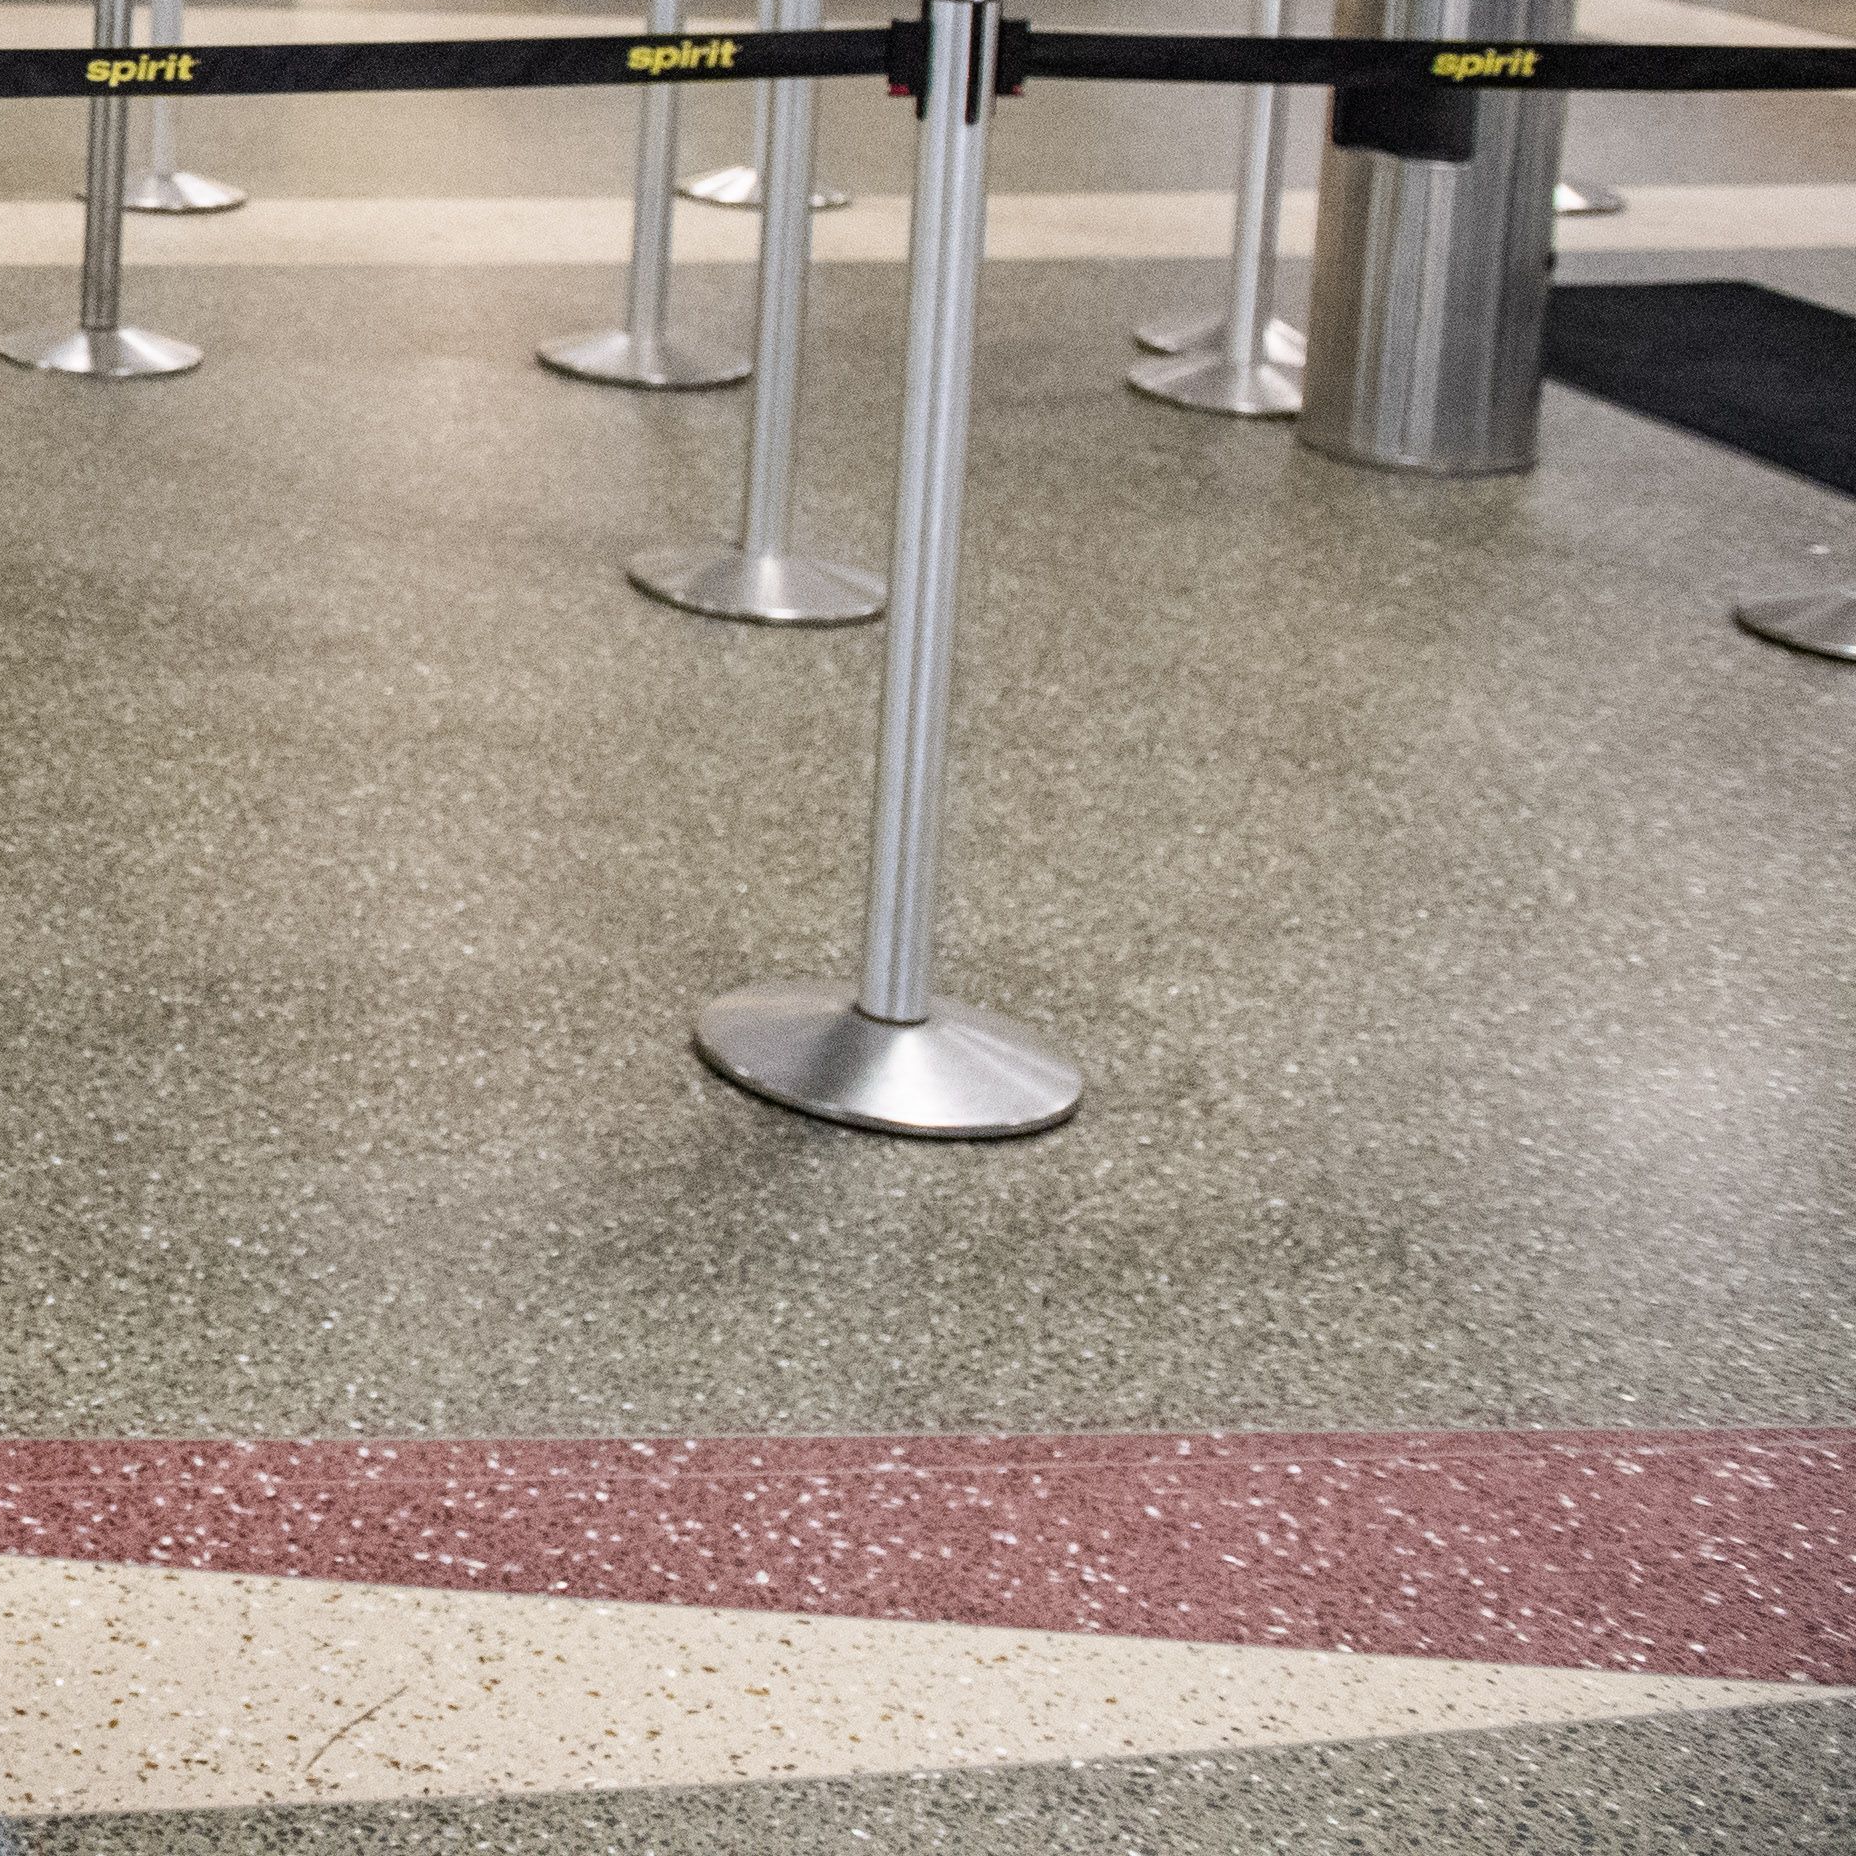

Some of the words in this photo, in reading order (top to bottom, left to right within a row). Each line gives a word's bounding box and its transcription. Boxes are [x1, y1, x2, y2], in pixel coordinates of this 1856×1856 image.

[86, 52, 195, 87] spirit
[627, 39, 736, 75] spirit
[1432, 48, 1538, 82] spirit
